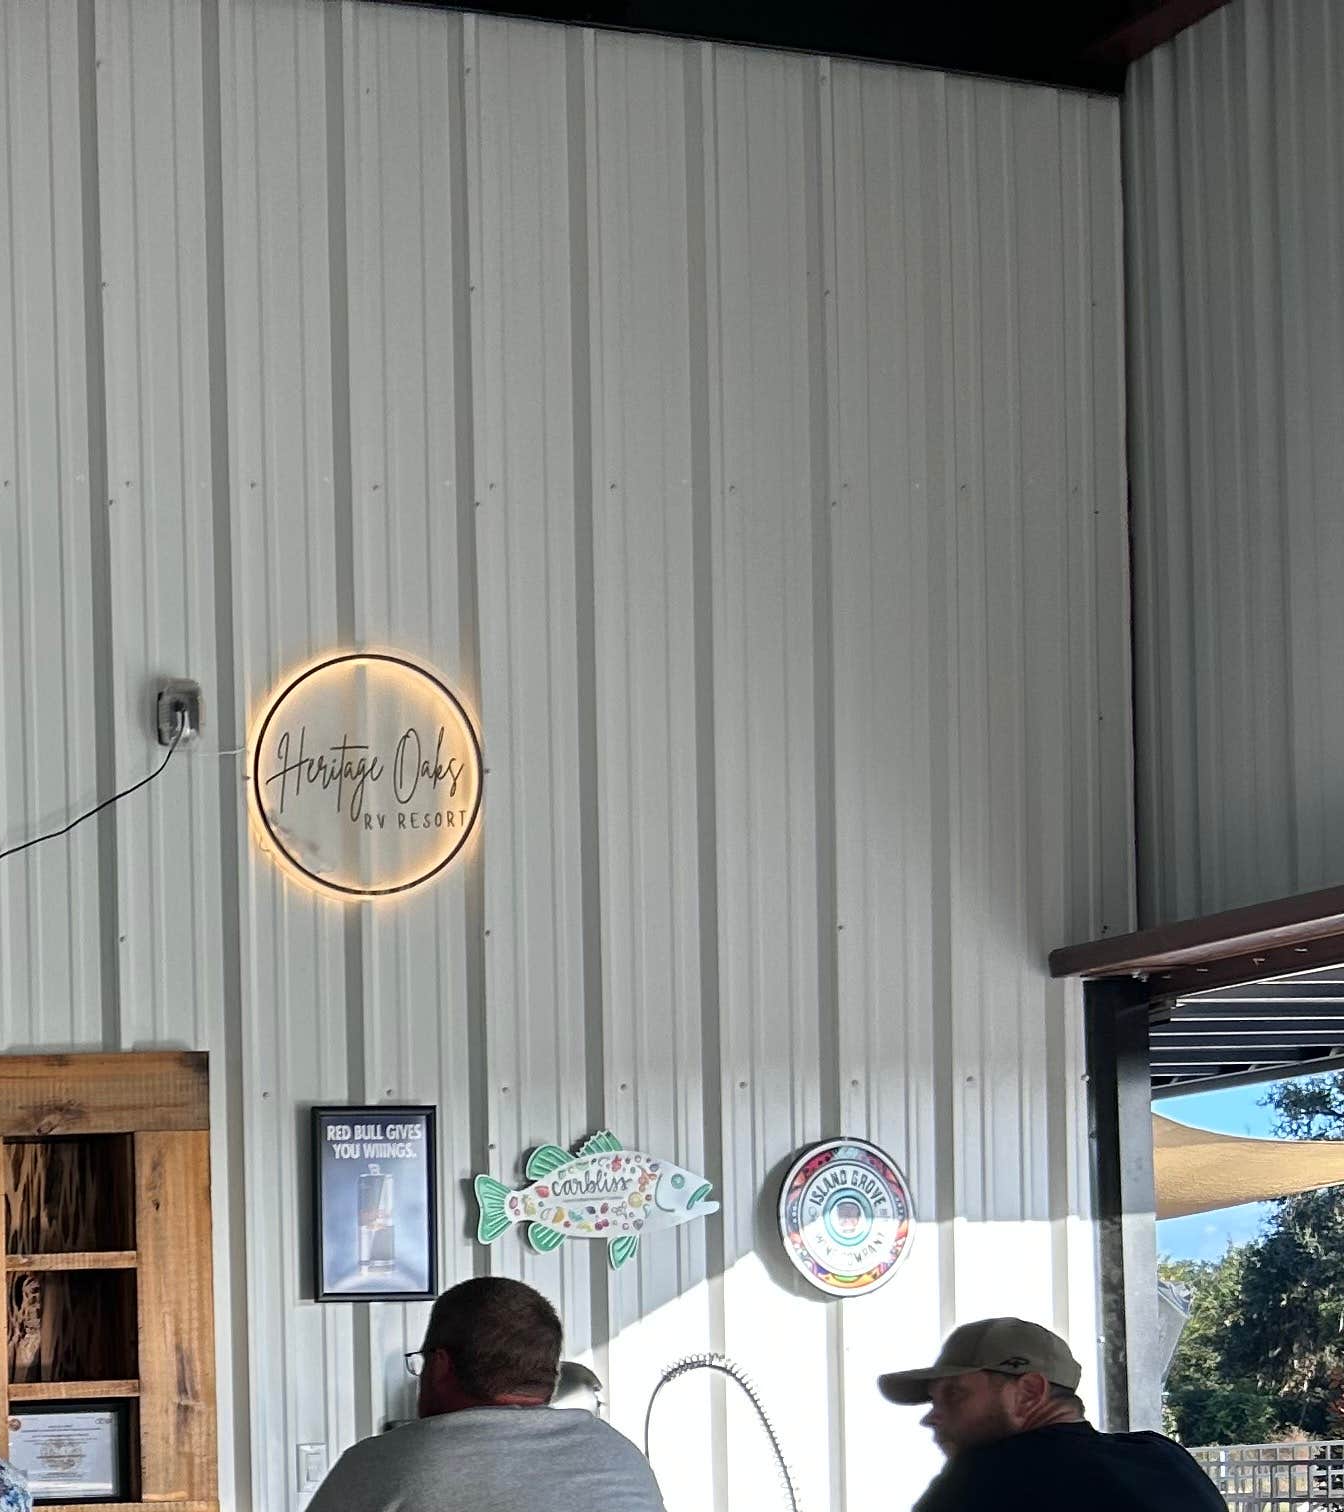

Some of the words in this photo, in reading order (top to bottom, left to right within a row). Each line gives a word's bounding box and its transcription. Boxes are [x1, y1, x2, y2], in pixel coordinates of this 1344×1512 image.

[266, 726, 384, 822] Heritage
[393, 727, 465, 804] Oaks
[364, 812, 385, 830] RV
[398, 810, 467, 829] RESORT
[326, 1124, 352, 1141] RED
[354, 1124, 384, 1141] BULL
[385, 1123, 422, 1141] GIVES
[332, 1143, 360, 1159] YOU
[552, 1169, 632, 1196] carbliss
[810, 1169, 848, 1206] ISLAND
[851, 1169, 887, 1207] GROVE
